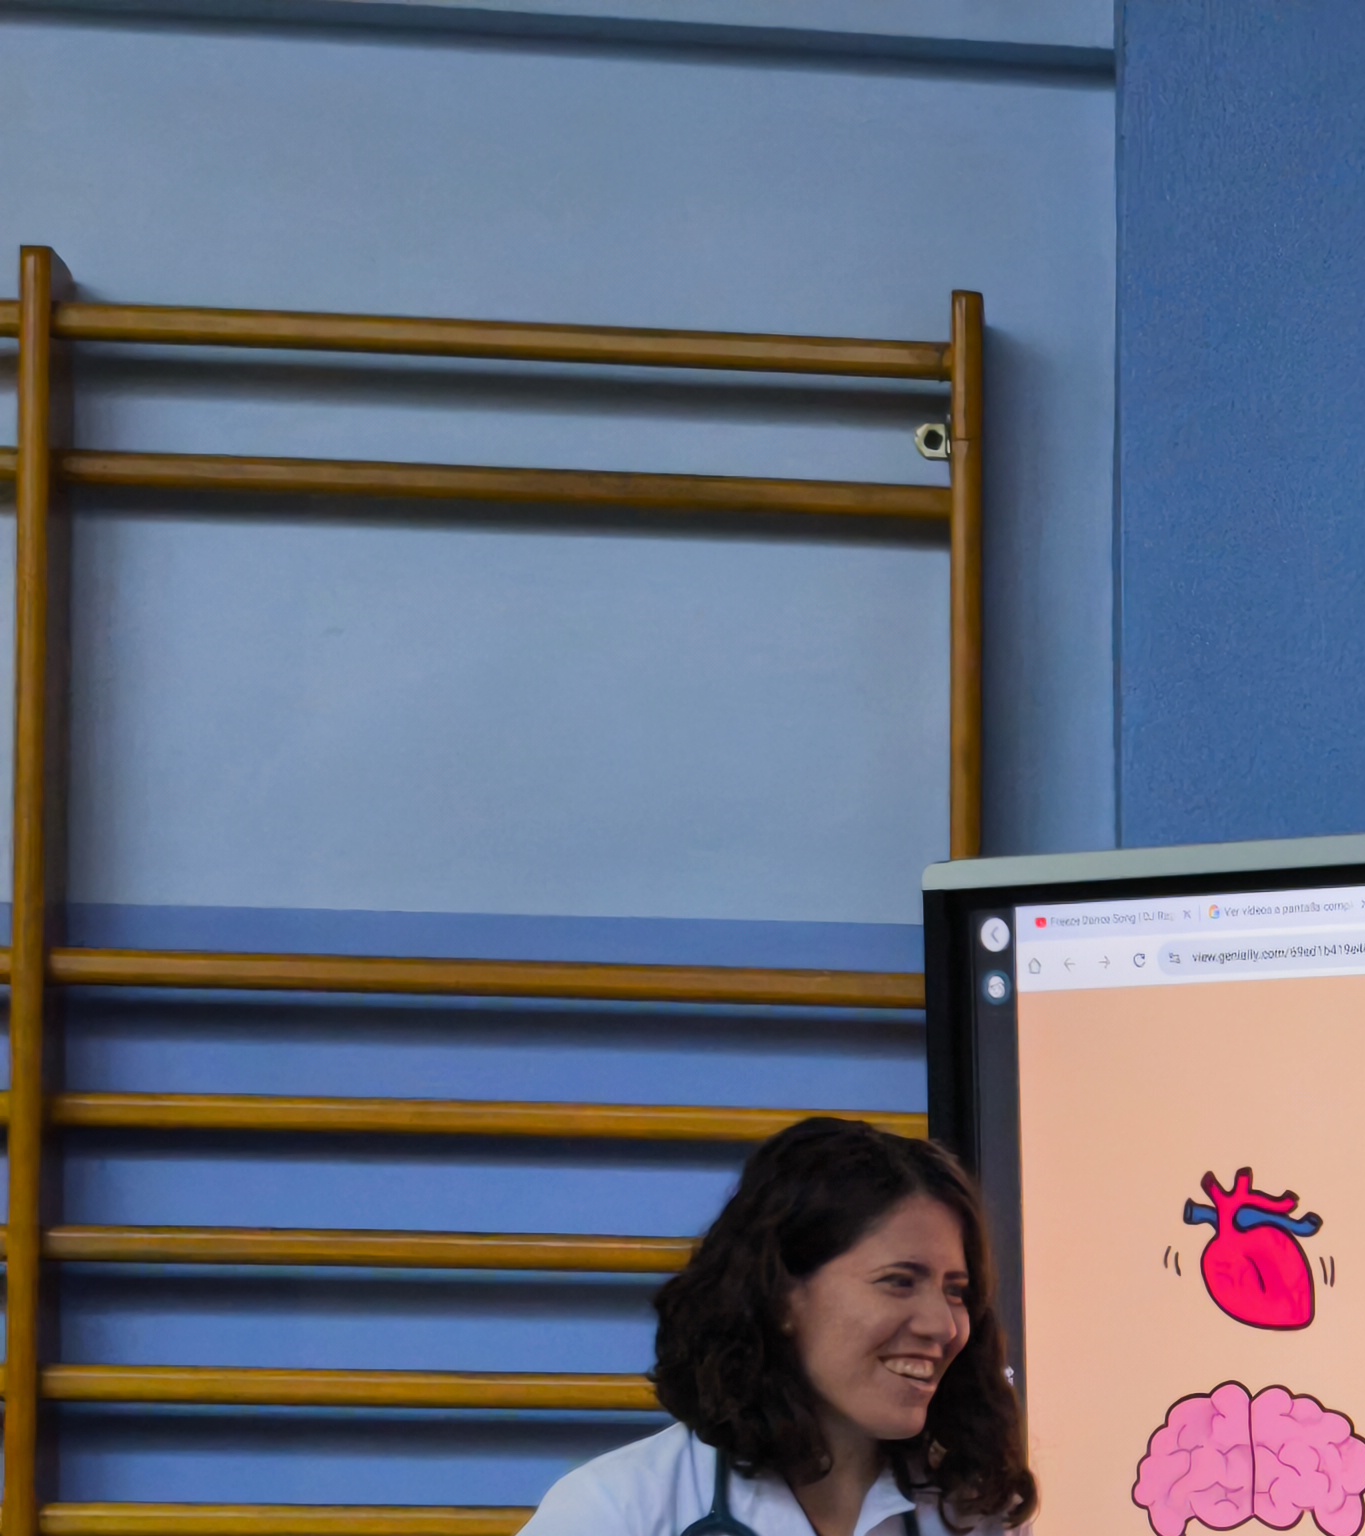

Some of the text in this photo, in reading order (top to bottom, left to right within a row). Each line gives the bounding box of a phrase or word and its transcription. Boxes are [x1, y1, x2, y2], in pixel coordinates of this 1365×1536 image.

[1224, 906, 1239, 917] Ver
[1275, 907, 1281, 915] a
[1282, 902, 1321, 916] pantalla
[1082, 914, 1110, 926] Dance
[1112, 912, 1136, 925] Song
[1143, 910, 1155, 921] DJ
